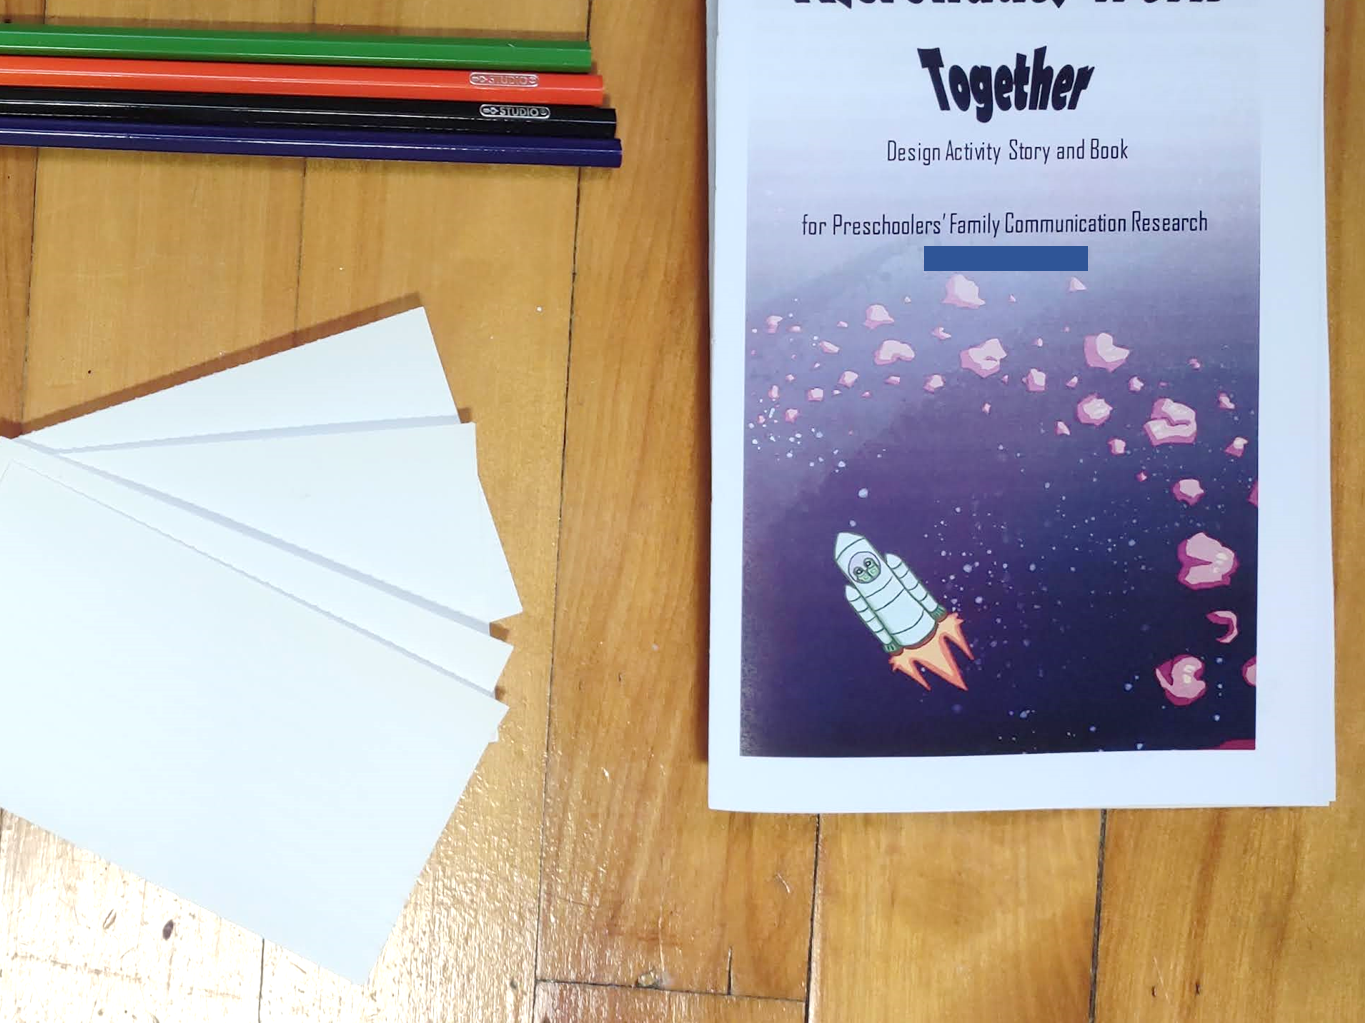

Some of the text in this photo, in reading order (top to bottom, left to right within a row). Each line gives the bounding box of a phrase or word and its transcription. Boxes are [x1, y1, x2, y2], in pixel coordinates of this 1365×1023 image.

[917, 45, 1095, 124] Together
[499, 106, 540, 117] STUDIO
[887, 137, 1129, 167] Design Activity Story and Book
[801, 209, 1209, 239] for Preschoolers' Family Communication Research
